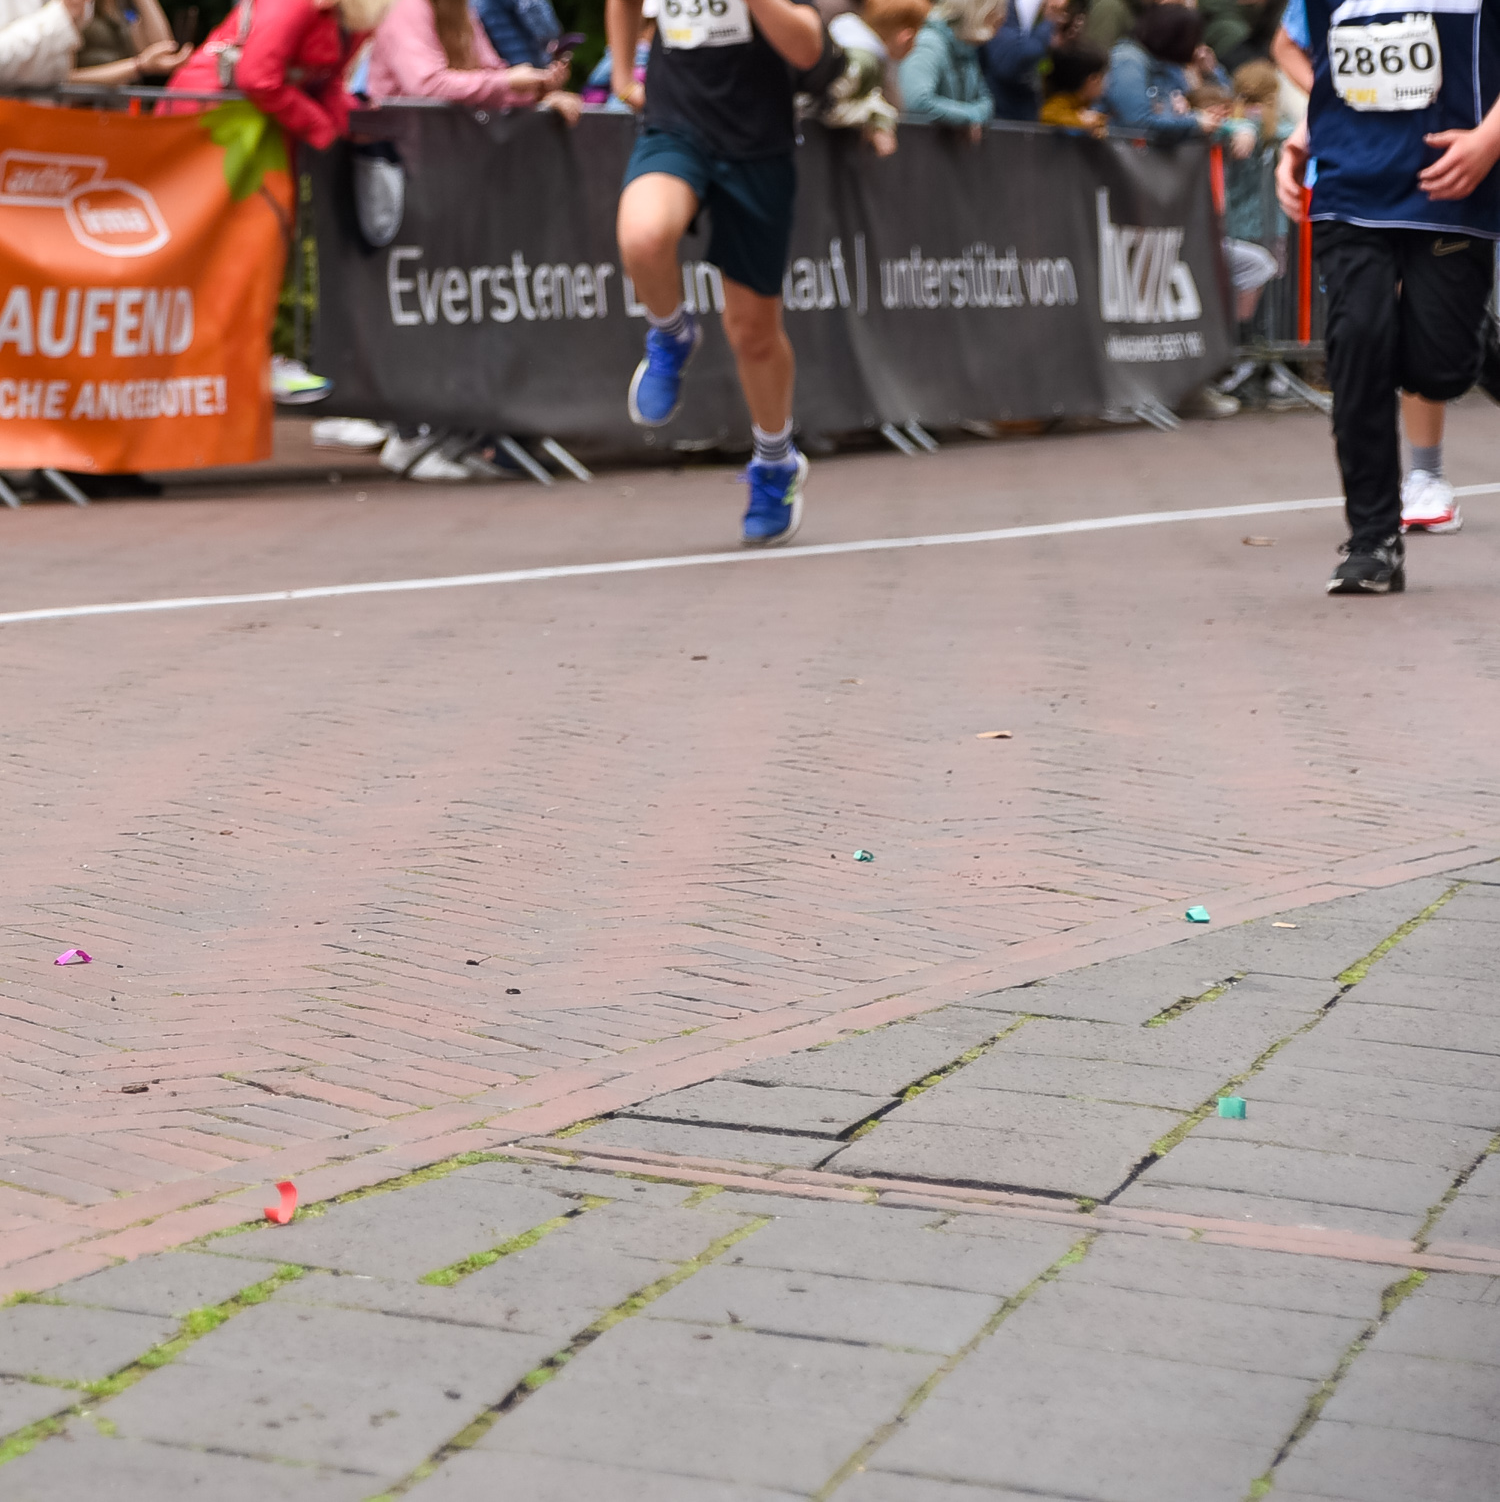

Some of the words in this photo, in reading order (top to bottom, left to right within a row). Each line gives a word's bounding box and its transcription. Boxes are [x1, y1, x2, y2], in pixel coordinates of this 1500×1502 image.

[1334, 41, 1434, 75] 2860
[386, 244, 615, 326] Everstener
[1020, 255, 1079, 307] von
[69, 374, 228, 421] ANGEBOTE!
